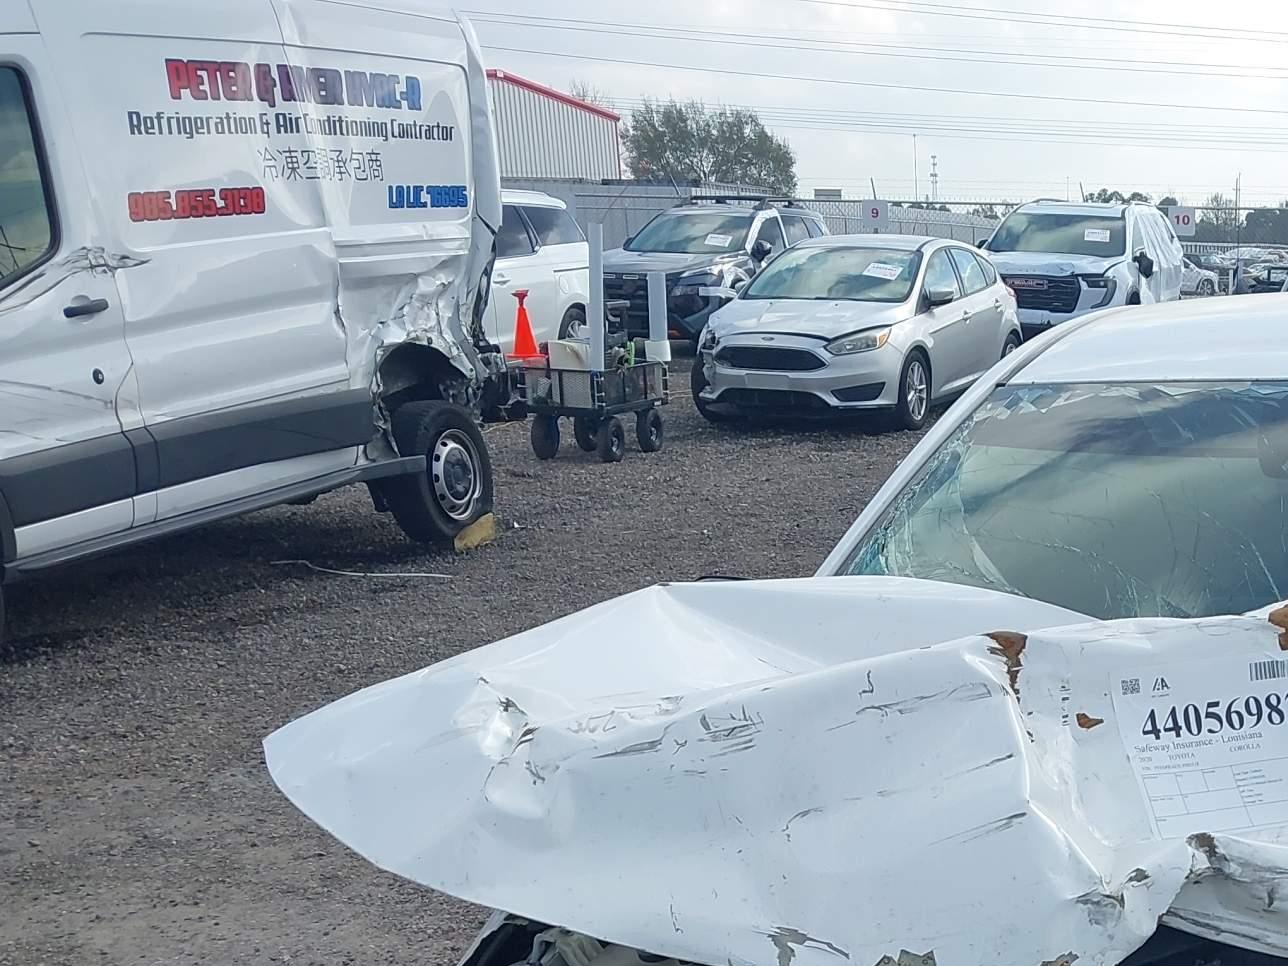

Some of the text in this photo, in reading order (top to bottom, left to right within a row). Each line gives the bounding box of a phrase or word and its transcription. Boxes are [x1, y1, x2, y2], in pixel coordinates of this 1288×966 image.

[164, 58, 253, 101] PETER
[254, 63, 276, 107] &
[127, 111, 454, 141] Refrigeration & Air Conditioning Contractor
[257, 146, 384, 182] 冷凍空調承包商
[388, 185, 404, 208] LA
[871, 207, 879, 218] 9
[1174, 214, 1190, 225] 10
[1134, 741, 1170, 753] Safeway
[1173, 737, 1213, 750] Insurance
[1221, 731, 1263, 744] Louisiana
[1168, 752, 1196, 761] TOYOTA
[1229, 743, 1261, 752] COROLLA
